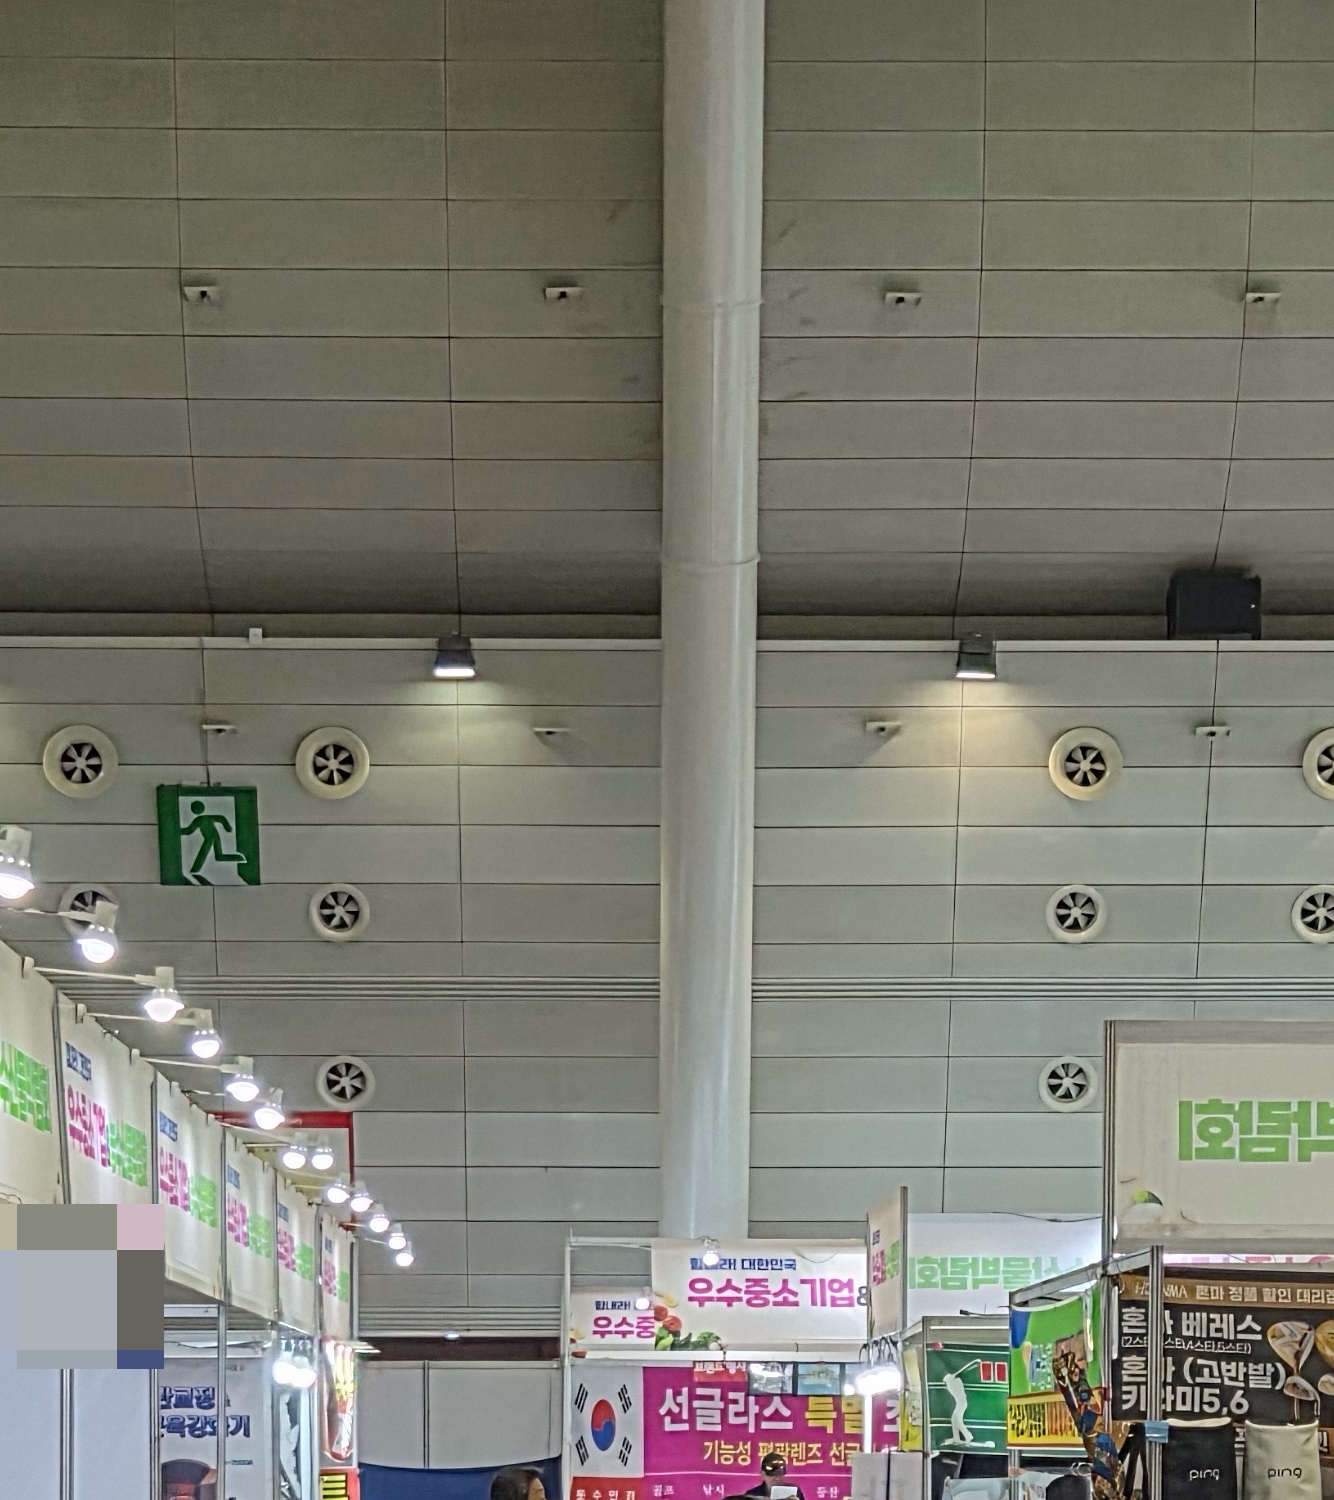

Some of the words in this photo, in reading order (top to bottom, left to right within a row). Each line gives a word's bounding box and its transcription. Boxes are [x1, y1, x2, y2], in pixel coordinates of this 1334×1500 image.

[690, 1257, 736, 1271] 힘라!
[741, 1257, 797, 1271] 대한민국
[687, 1277, 800, 1308] 우수중소
[1181, 1310, 1263, 1341] 베레스
[1183, 1356, 1287, 1391] (고반발)
[658, 1386, 794, 1433] 선글라스
[703, 1440, 752, 1466] 기능성
[1267, 1467, 1303, 1480] ping
